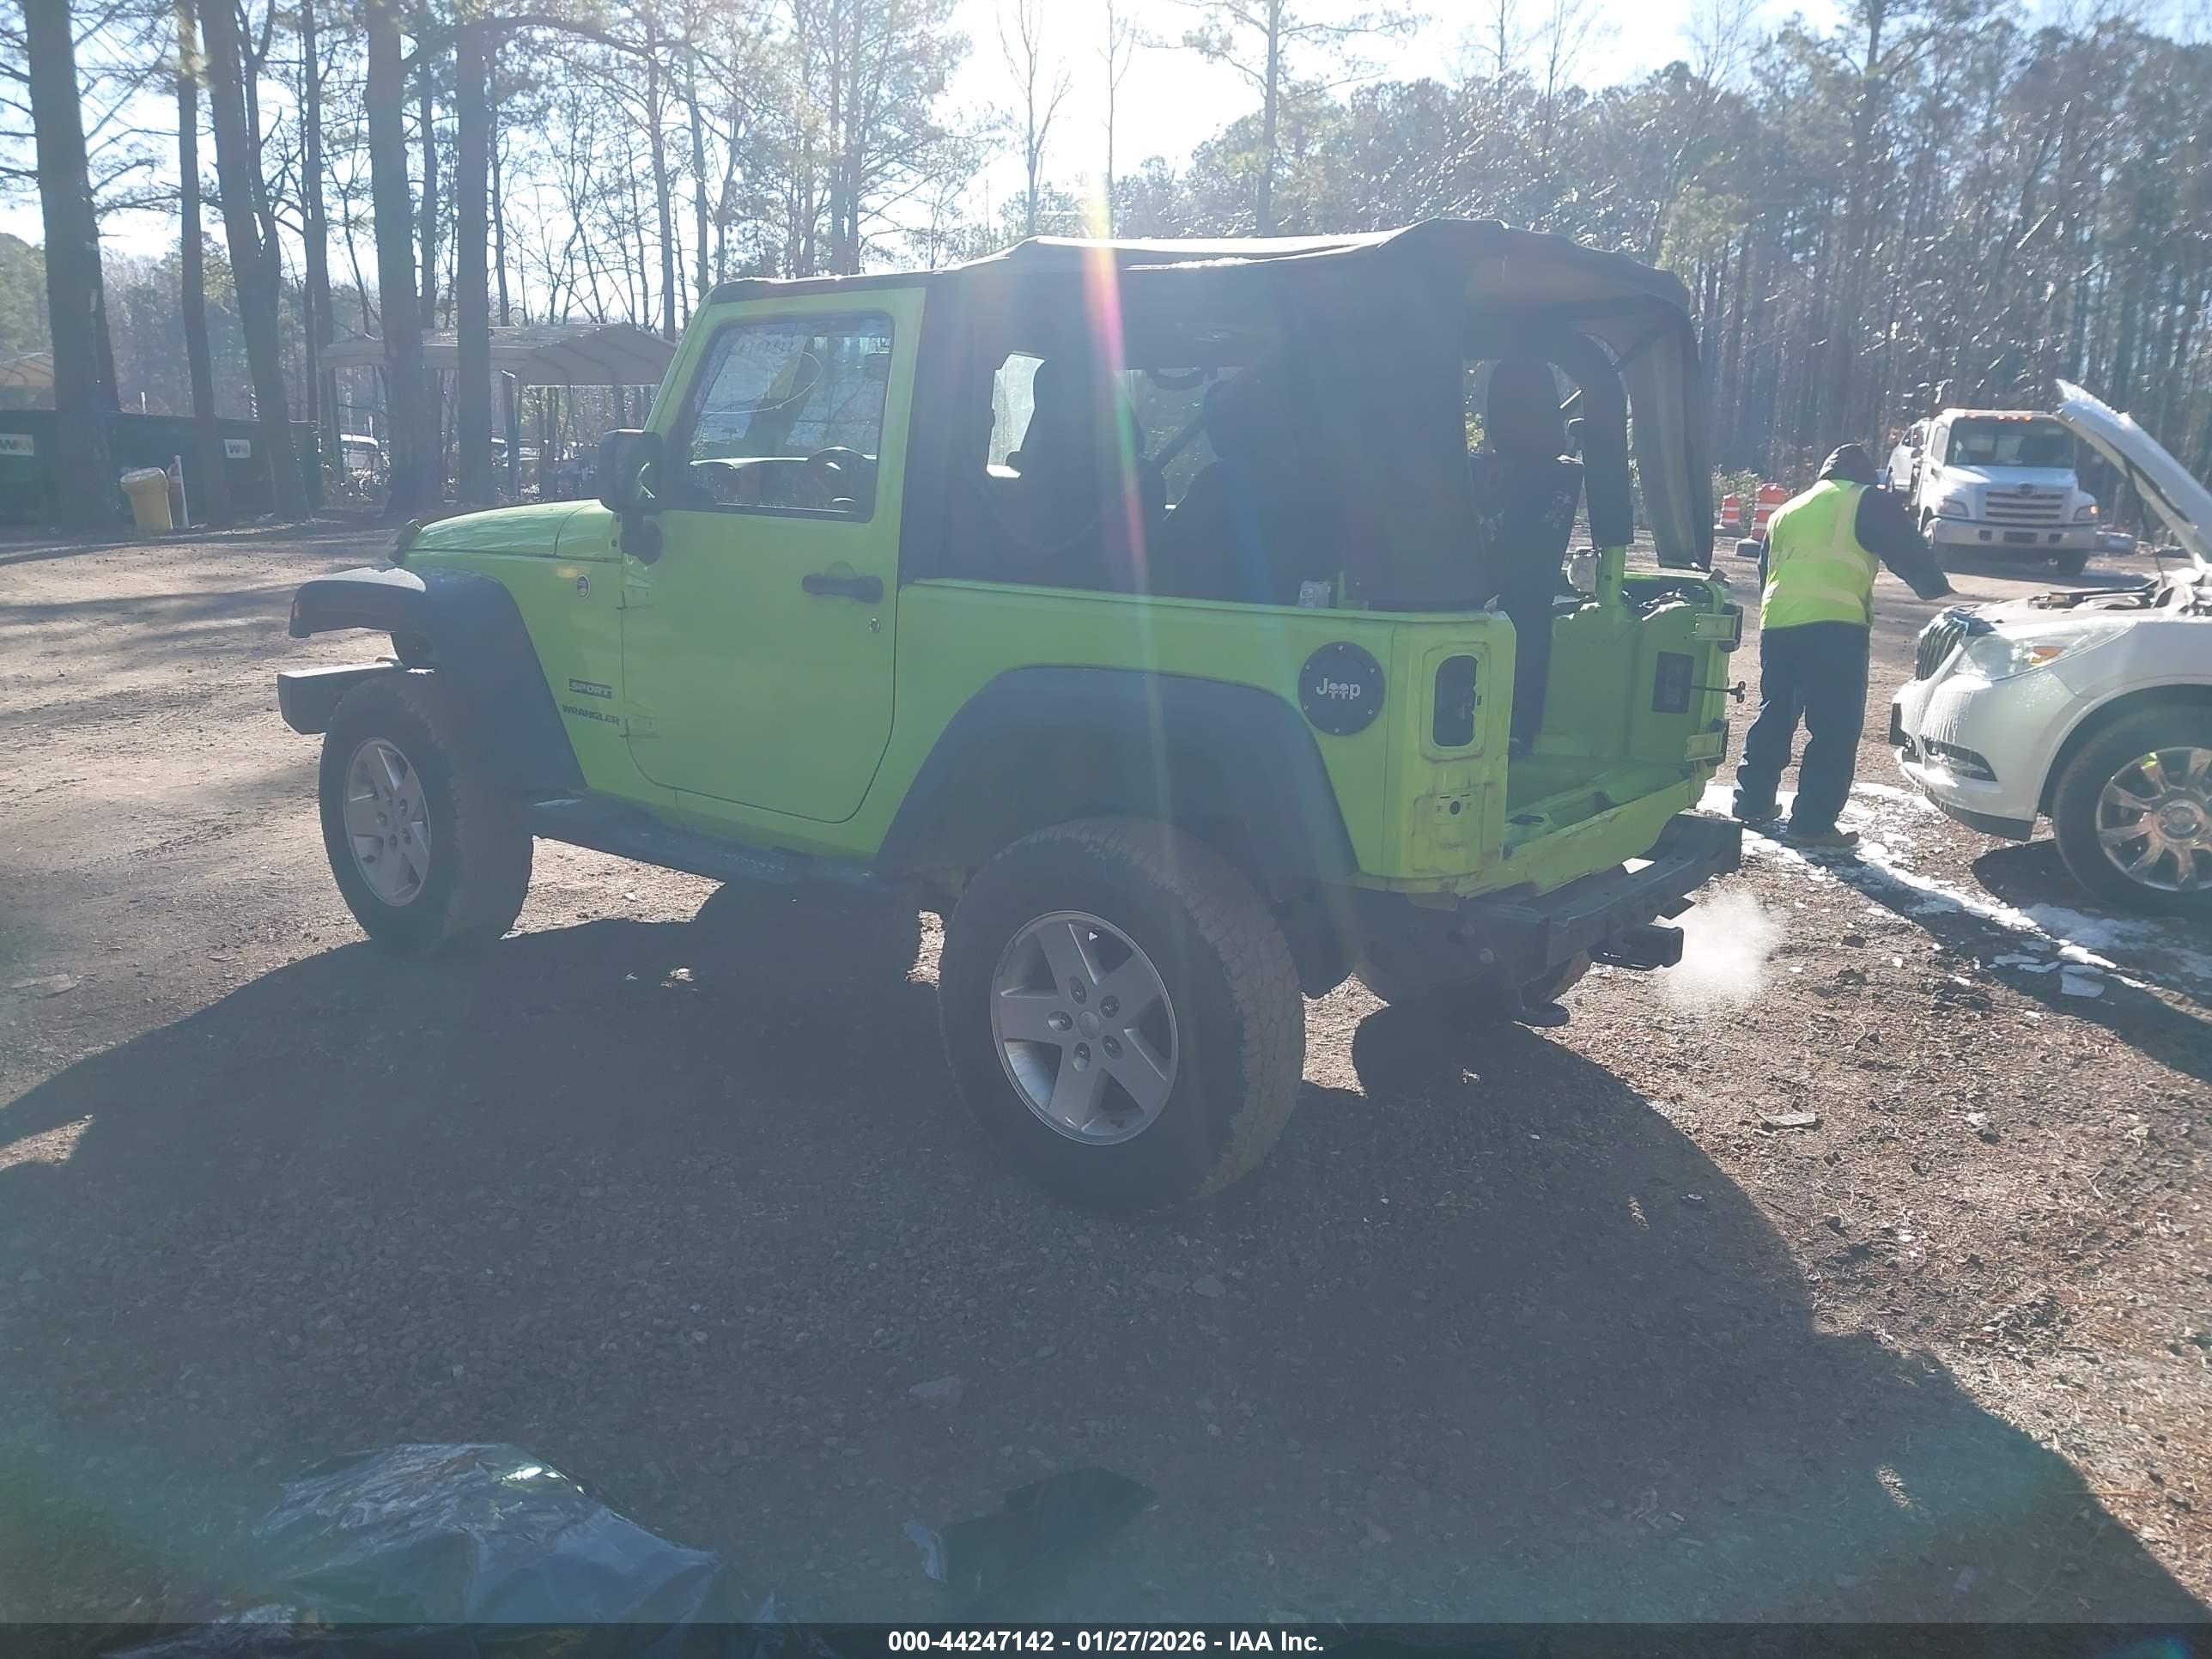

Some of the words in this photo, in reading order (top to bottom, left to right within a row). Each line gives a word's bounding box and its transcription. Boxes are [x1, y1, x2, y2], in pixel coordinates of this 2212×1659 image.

[571, 682, 612, 697] SPORT
[1316, 678, 1361, 701] Jeep
[562, 705, 619, 726] WRANGLER
